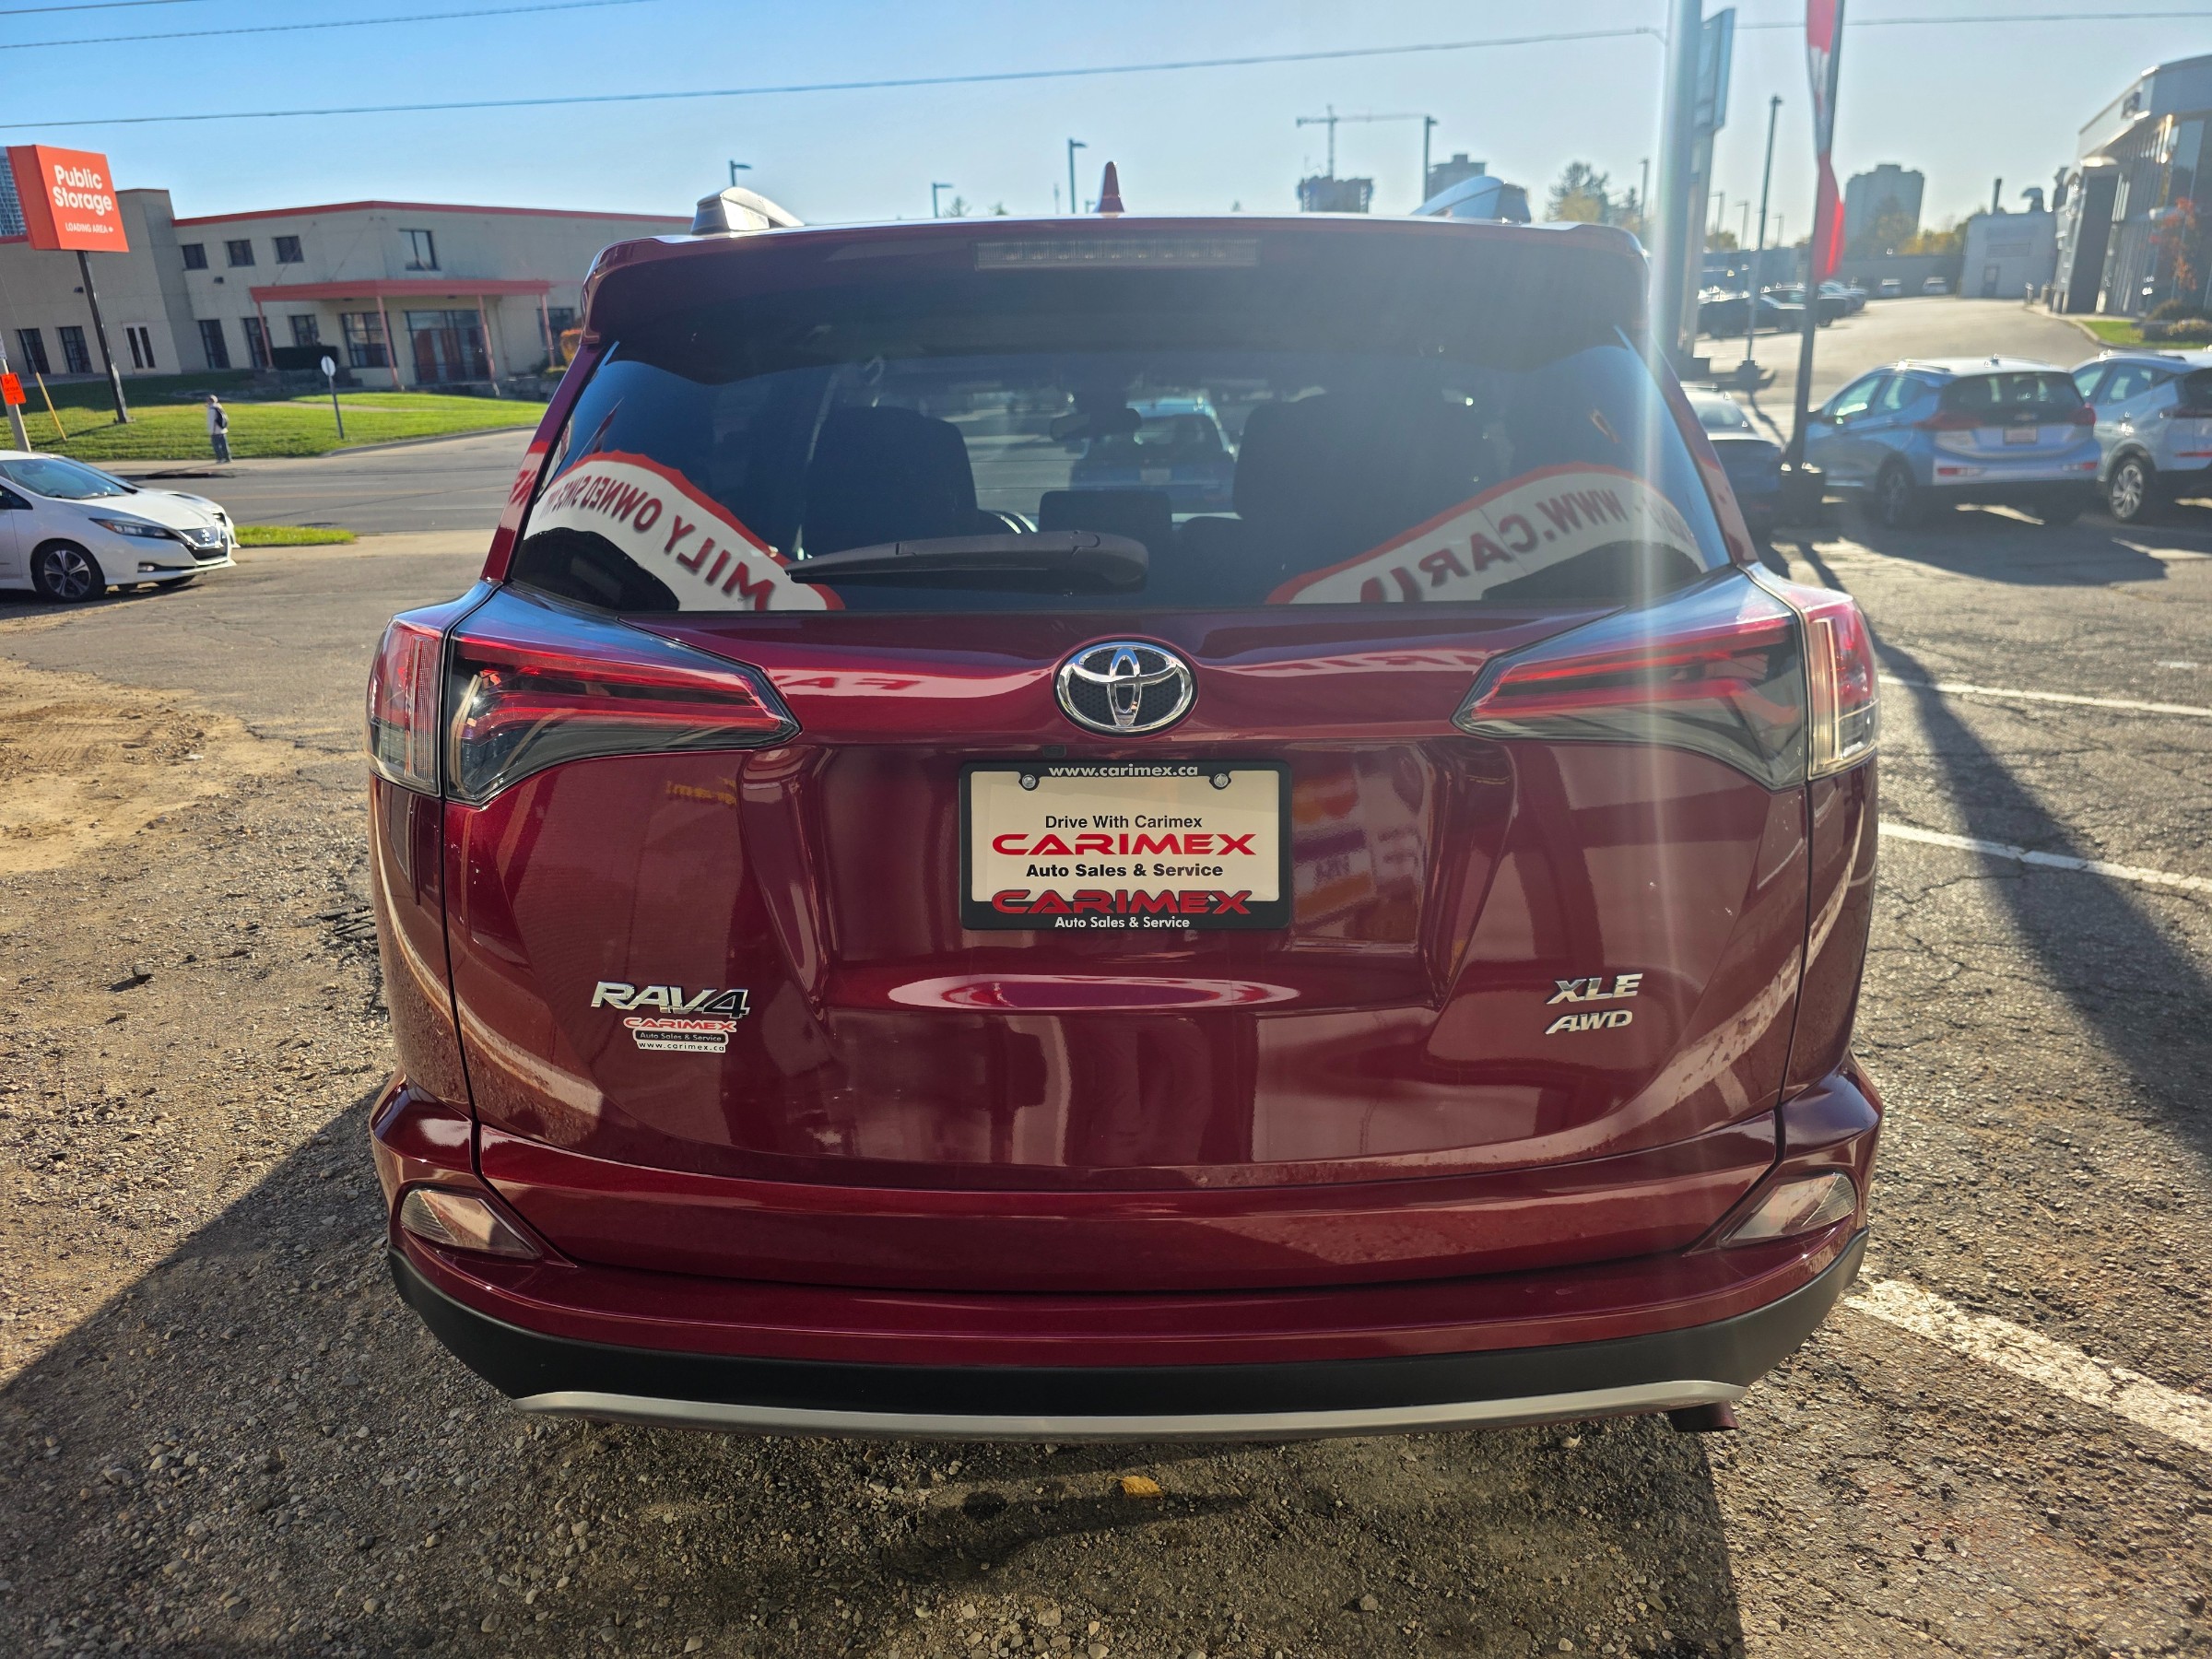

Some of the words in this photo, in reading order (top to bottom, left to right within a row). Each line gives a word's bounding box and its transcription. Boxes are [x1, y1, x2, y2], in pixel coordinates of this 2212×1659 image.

[53, 164, 103, 190] Public
[52, 186, 112, 217] Storage
[65, 221, 92, 233] LOADING
[92, 224, 109, 234] AREA
[1048, 764, 1198, 778] www.carimex.ca
[1045, 815, 1088, 829] Drive
[1092, 815, 1130, 829] With
[1134, 815, 1203, 829] Carimex
[992, 833, 1257, 855] CARIMEX
[1026, 864, 1070, 877] Auto
[1075, 864, 1127, 877] Sales
[1133, 864, 1147, 877] &
[1153, 864, 1223, 877] Service
[992, 889, 1253, 914] CARIMEX
[1054, 916, 1087, 928] Auto
[1089, 915, 1125, 928] Sales
[1129, 916, 1139, 928] &
[1142, 915, 1191, 928] Service
[1546, 973, 1643, 1005] XLE
[591, 981, 750, 1019] RAV4
[625, 1018, 736, 1031] CARIMEX
[1545, 1009, 1633, 1034] AWD
[660, 1032, 682, 1041] Sales
[692, 1033, 722, 1042] Service
[638, 1041, 725, 1053] www.carimex.ca
